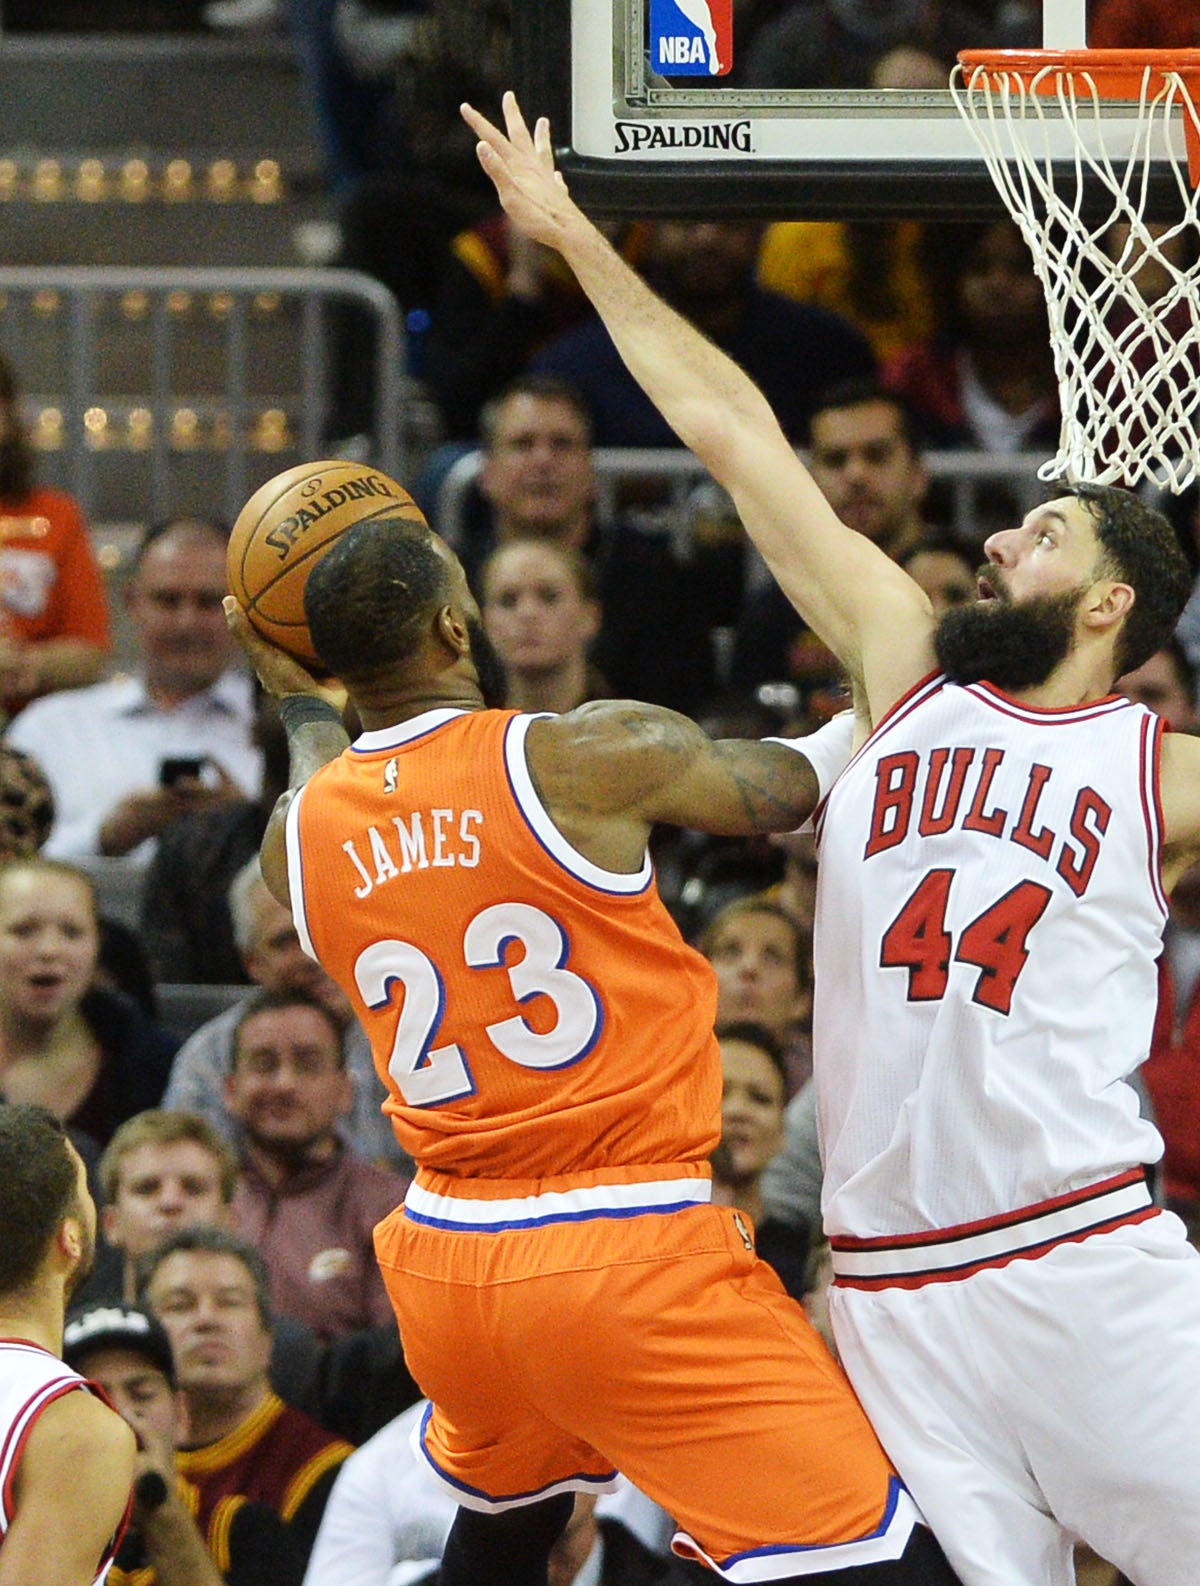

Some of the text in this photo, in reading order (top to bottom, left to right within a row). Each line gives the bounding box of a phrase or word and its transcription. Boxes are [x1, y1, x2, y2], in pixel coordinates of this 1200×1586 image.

[659, 36, 706, 64] NBA
[614, 120, 752, 153] SPALDING
[265, 475, 394, 562] SPALDING
[341, 808, 483, 899] JAMES
[863, 747, 1113, 899] BULLS
[879, 867, 1054, 1017] 44
[353, 901, 605, 1107] 23
